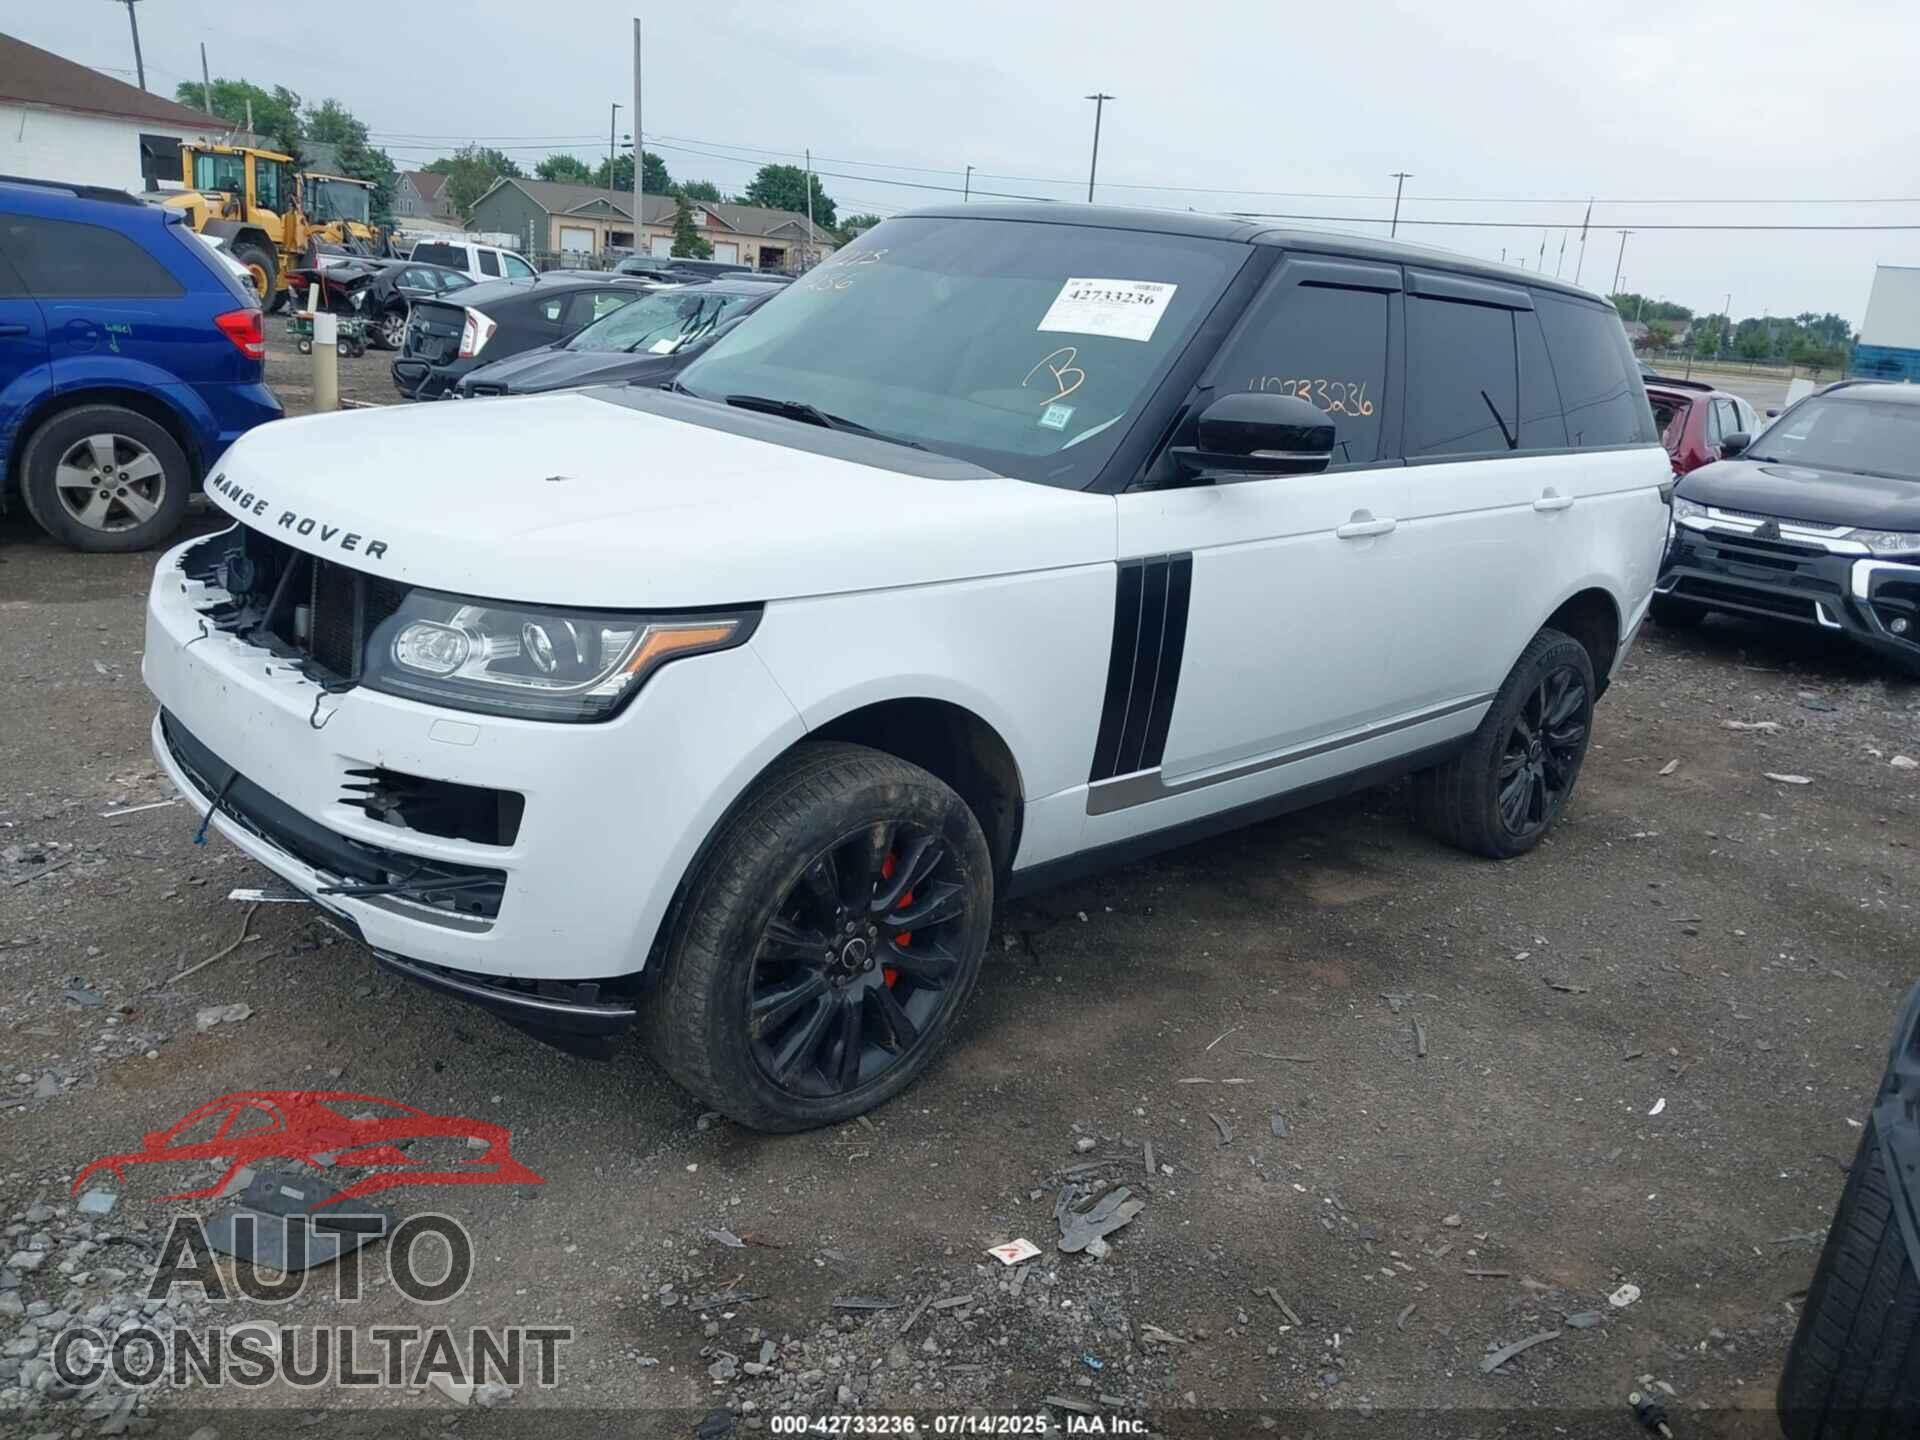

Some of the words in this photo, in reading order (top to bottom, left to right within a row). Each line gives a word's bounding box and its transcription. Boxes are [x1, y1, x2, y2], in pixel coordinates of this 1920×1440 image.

[1069, 289, 1155, 305] 42733236
[1022, 347, 1085, 406] B
[212, 472, 269, 517] RANGE
[278, 511, 388, 560] ROVER
